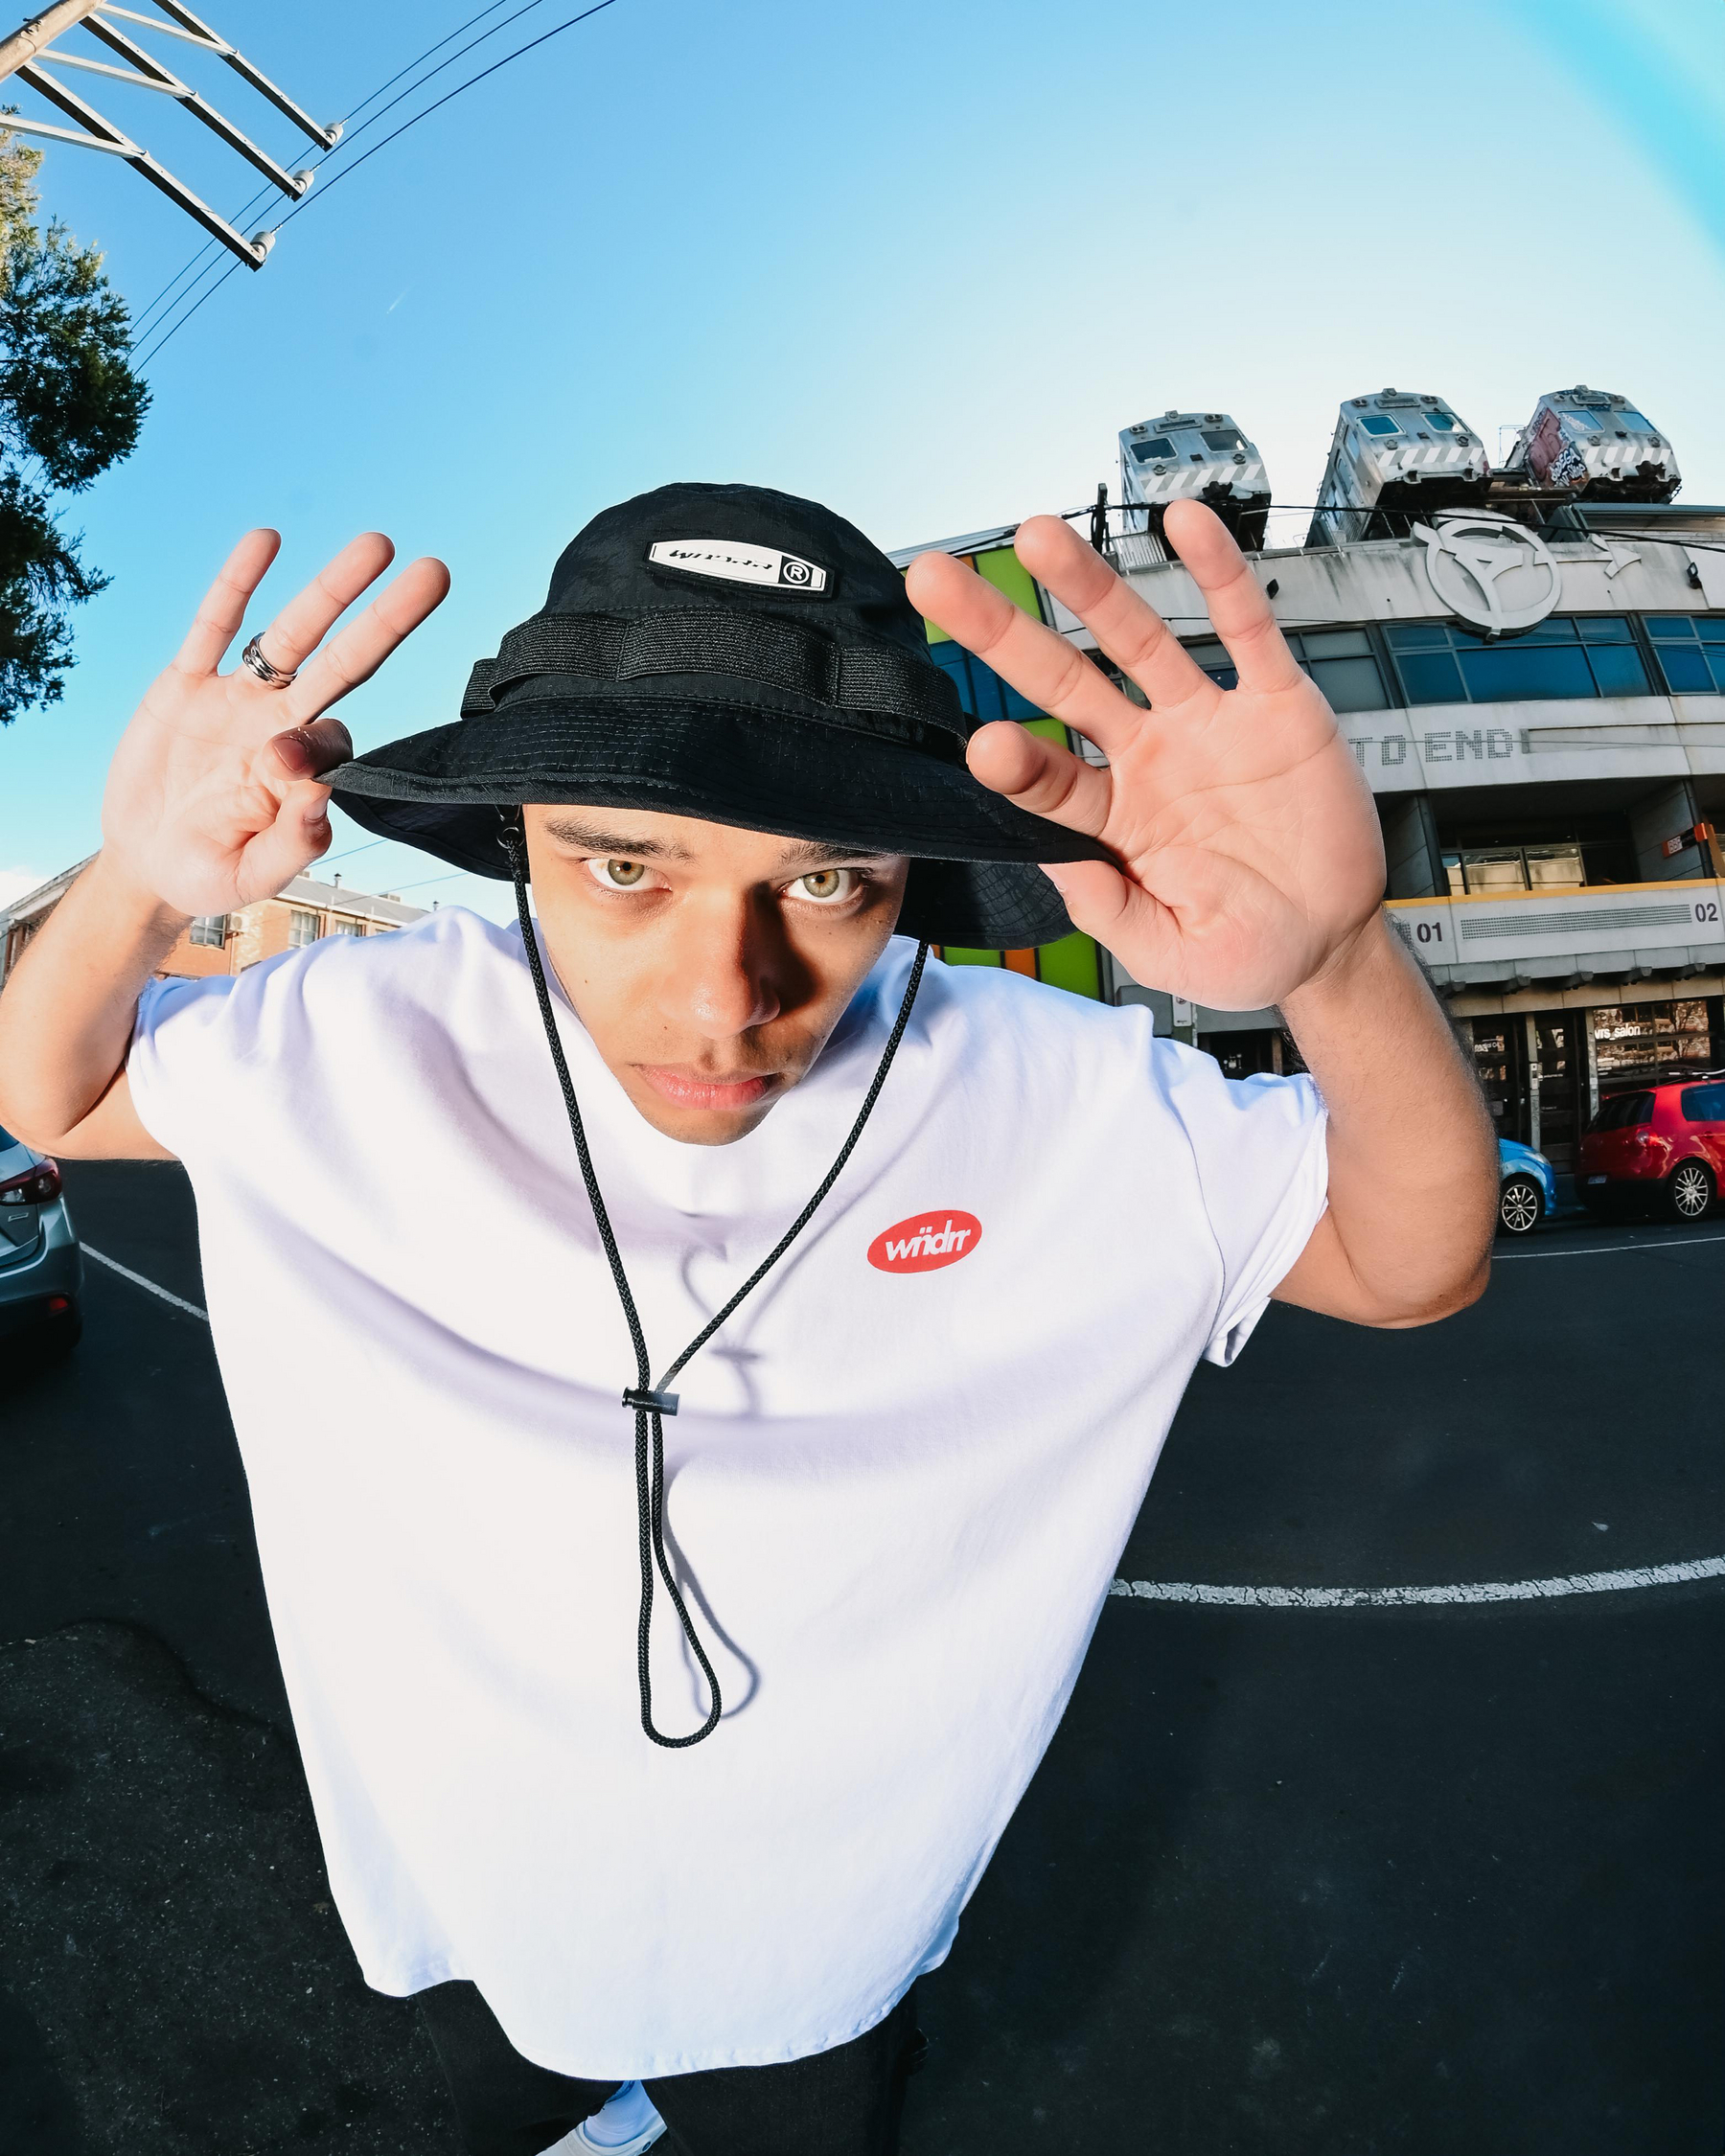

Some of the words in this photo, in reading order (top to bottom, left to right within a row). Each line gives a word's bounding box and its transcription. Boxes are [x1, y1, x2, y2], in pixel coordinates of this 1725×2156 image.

[1347, 734, 1407, 767] TO
[1424, 728, 1513, 763] END
[1694, 903, 1718, 923] 02
[1416, 922, 1443, 944] 01
